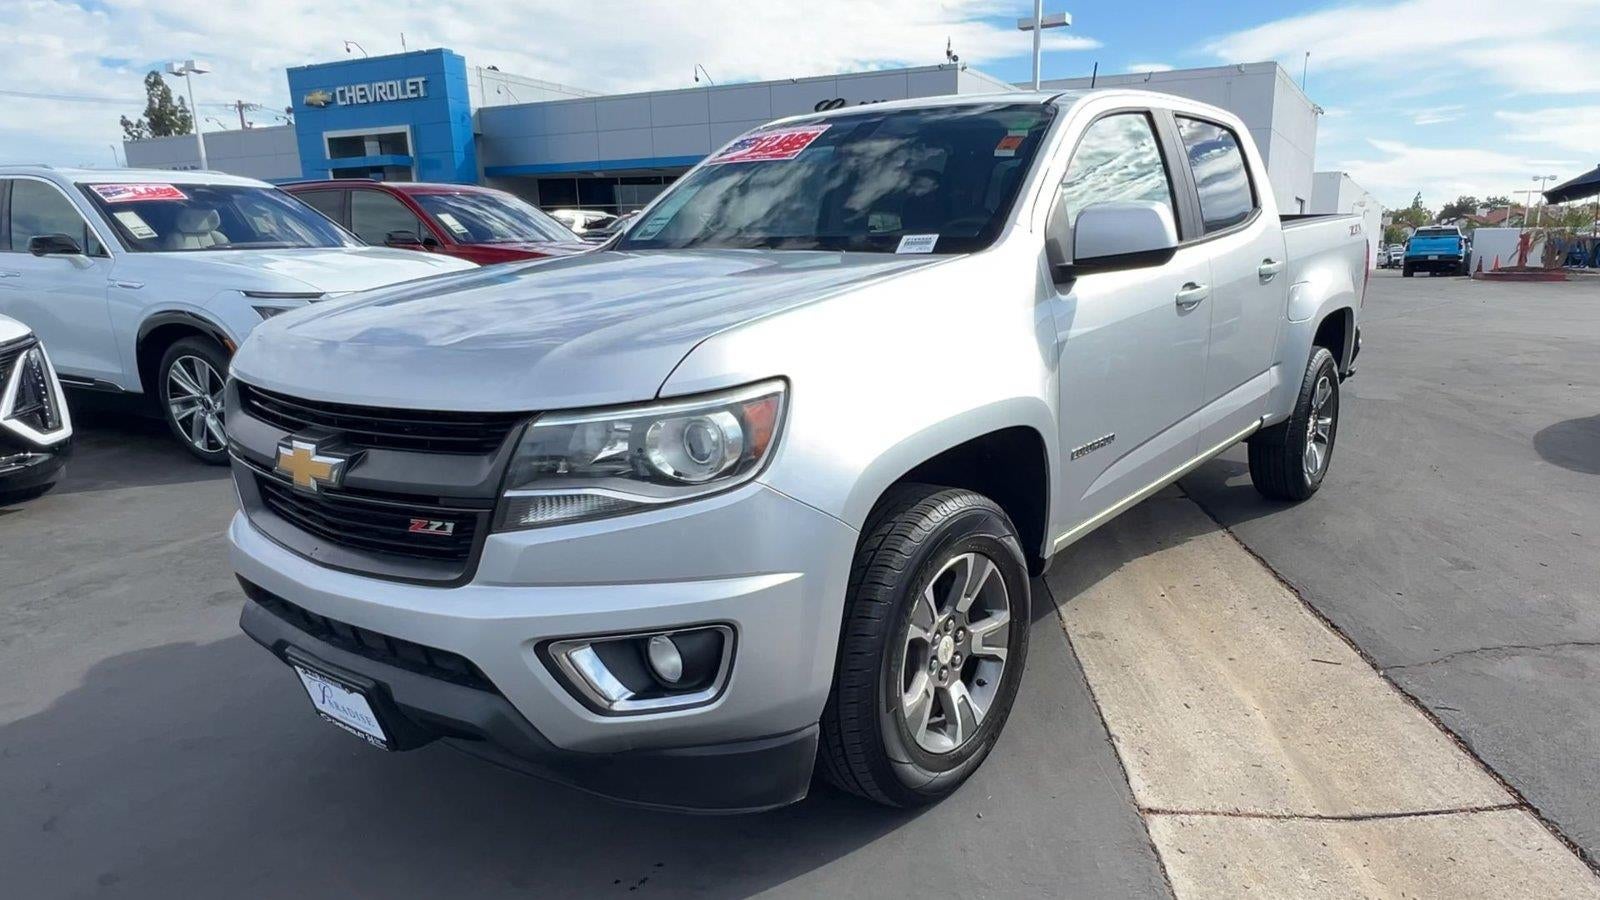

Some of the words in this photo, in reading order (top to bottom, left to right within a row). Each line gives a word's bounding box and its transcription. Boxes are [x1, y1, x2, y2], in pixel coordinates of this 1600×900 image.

[336, 77, 426, 106] CHEVROLET
[408, 518, 455, 536] Z71
[318, 682, 376, 727] PARADISE
